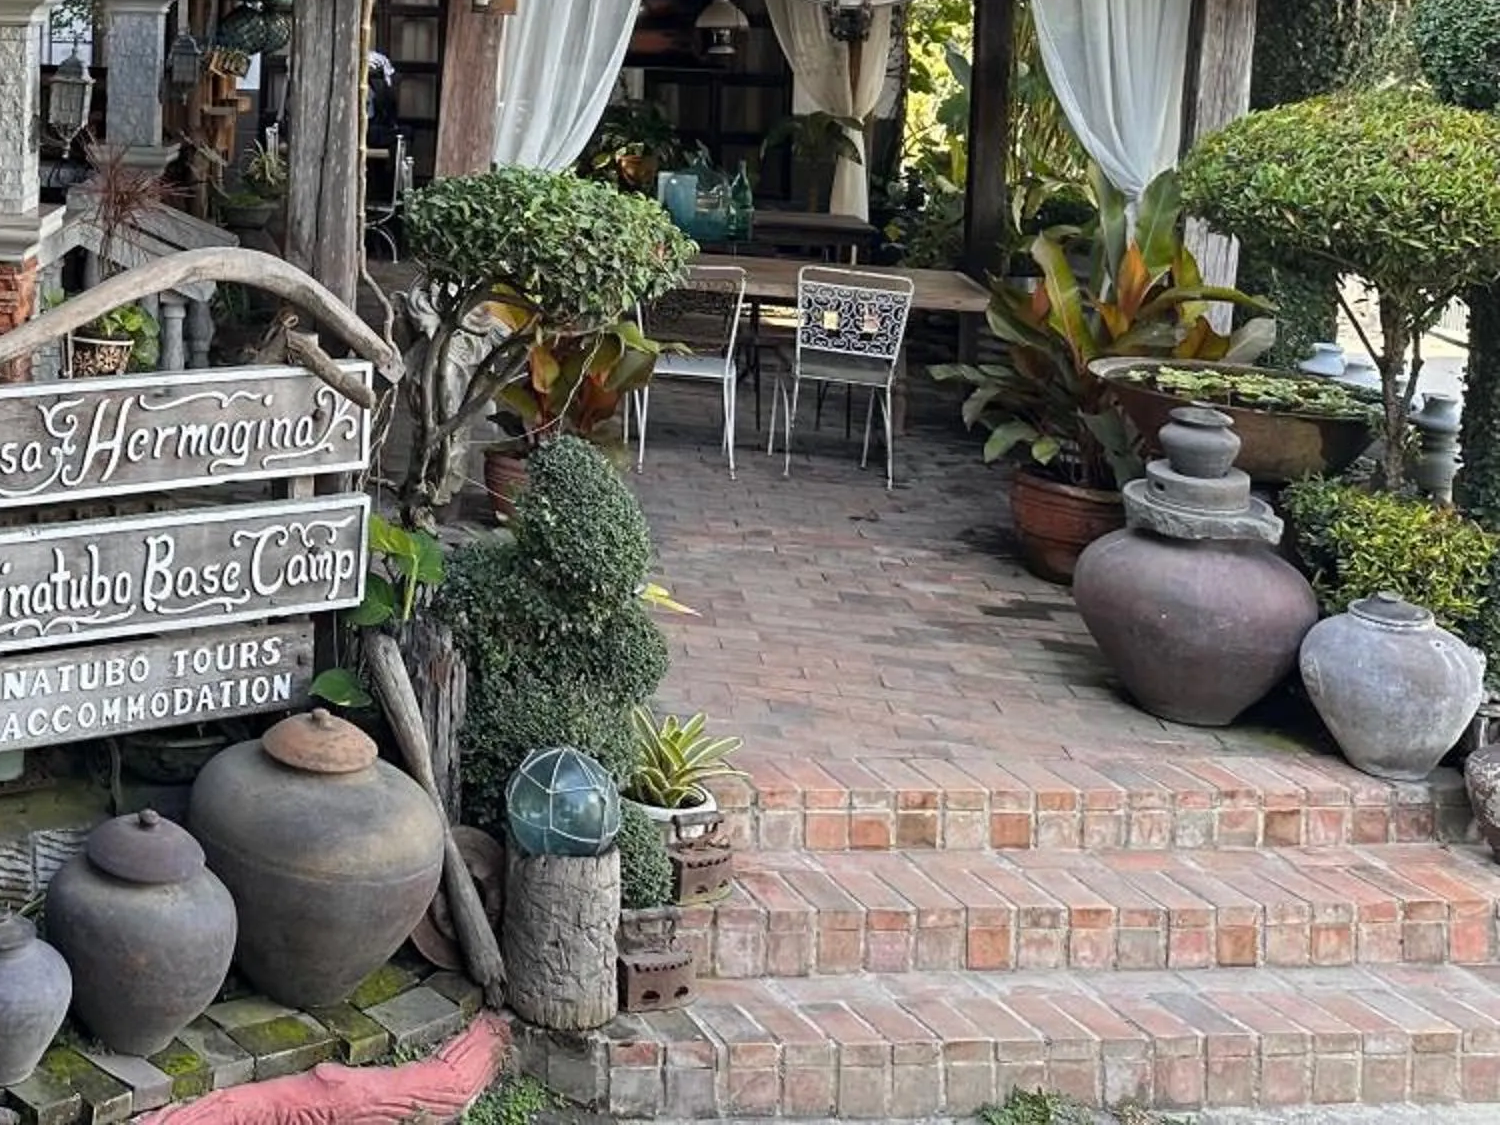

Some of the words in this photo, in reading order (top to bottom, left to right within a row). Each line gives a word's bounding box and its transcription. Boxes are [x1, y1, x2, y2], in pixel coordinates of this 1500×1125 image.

[143, 533, 241, 611] Base
[232, 525, 354, 600] Camp
[173, 636, 283, 677] TOURS
[0, 673, 292, 743] ACCOMMODATION
